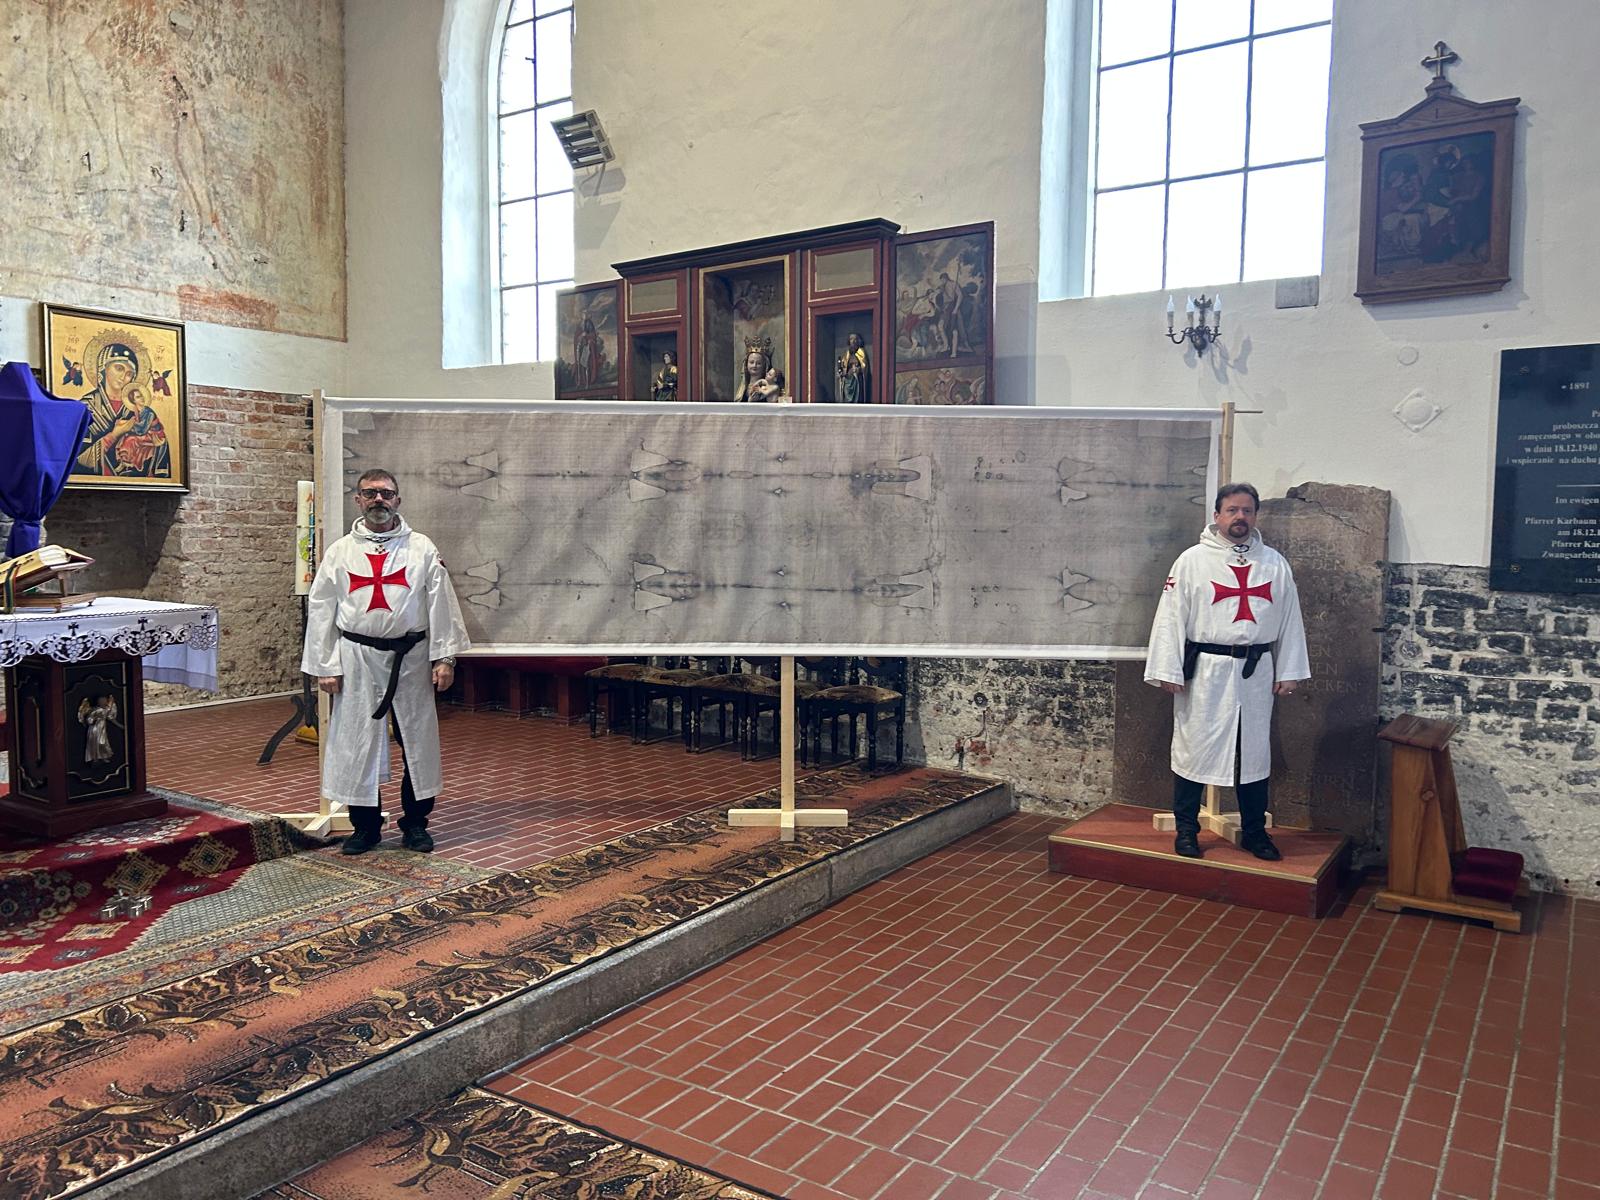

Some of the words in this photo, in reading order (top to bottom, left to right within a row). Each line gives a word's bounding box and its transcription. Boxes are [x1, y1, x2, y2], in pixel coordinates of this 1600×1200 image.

[1552, 422, 1599, 431] proboszcza
[1533, 445, 1552, 453] dniu
[1555, 443, 1598, 452] 18.12.1940
[1511, 456, 1554, 465] wspieranie
[1571, 456, 1597, 464] duchu
[1555, 496, 1568, 504] Im
[1570, 496, 1600, 505] ewigen
[1524, 517, 1554, 525] Pfarrer
[1557, 517, 1597, 525] Karbaum
[1551, 540, 1582, 548] Pfarrer
